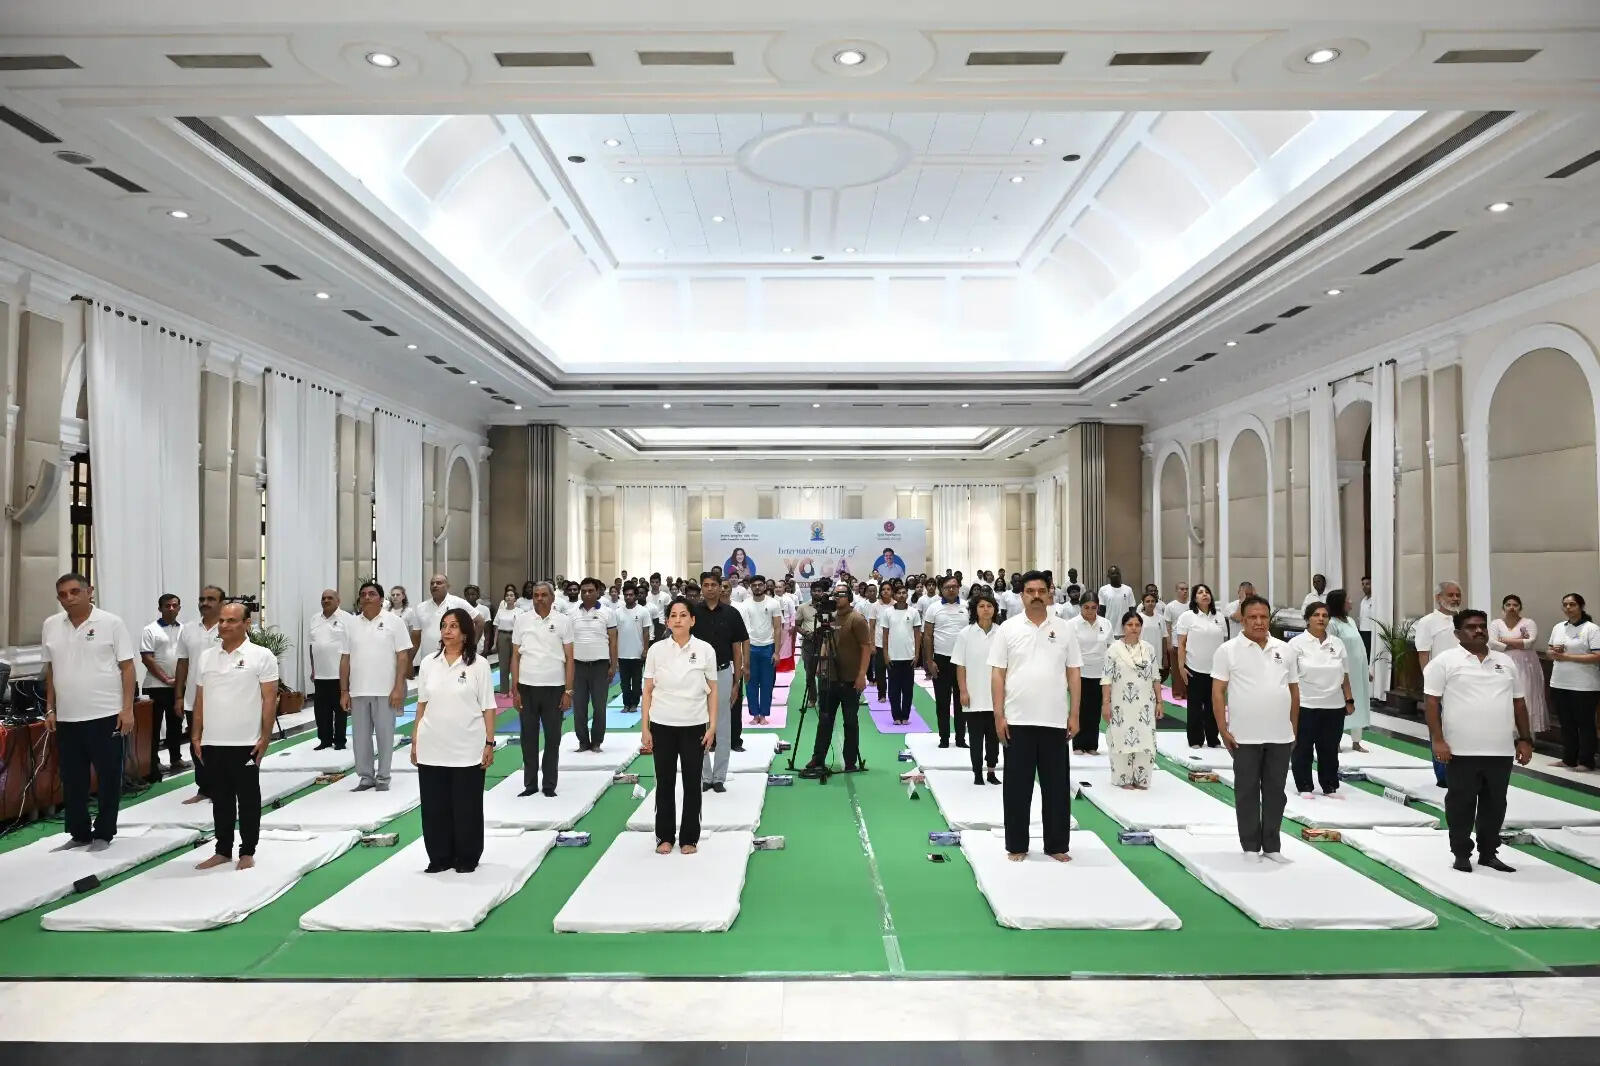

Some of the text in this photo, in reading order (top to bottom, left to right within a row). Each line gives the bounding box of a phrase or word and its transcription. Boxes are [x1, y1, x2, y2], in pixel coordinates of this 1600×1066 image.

[778, 545, 859, 558] International Day of
